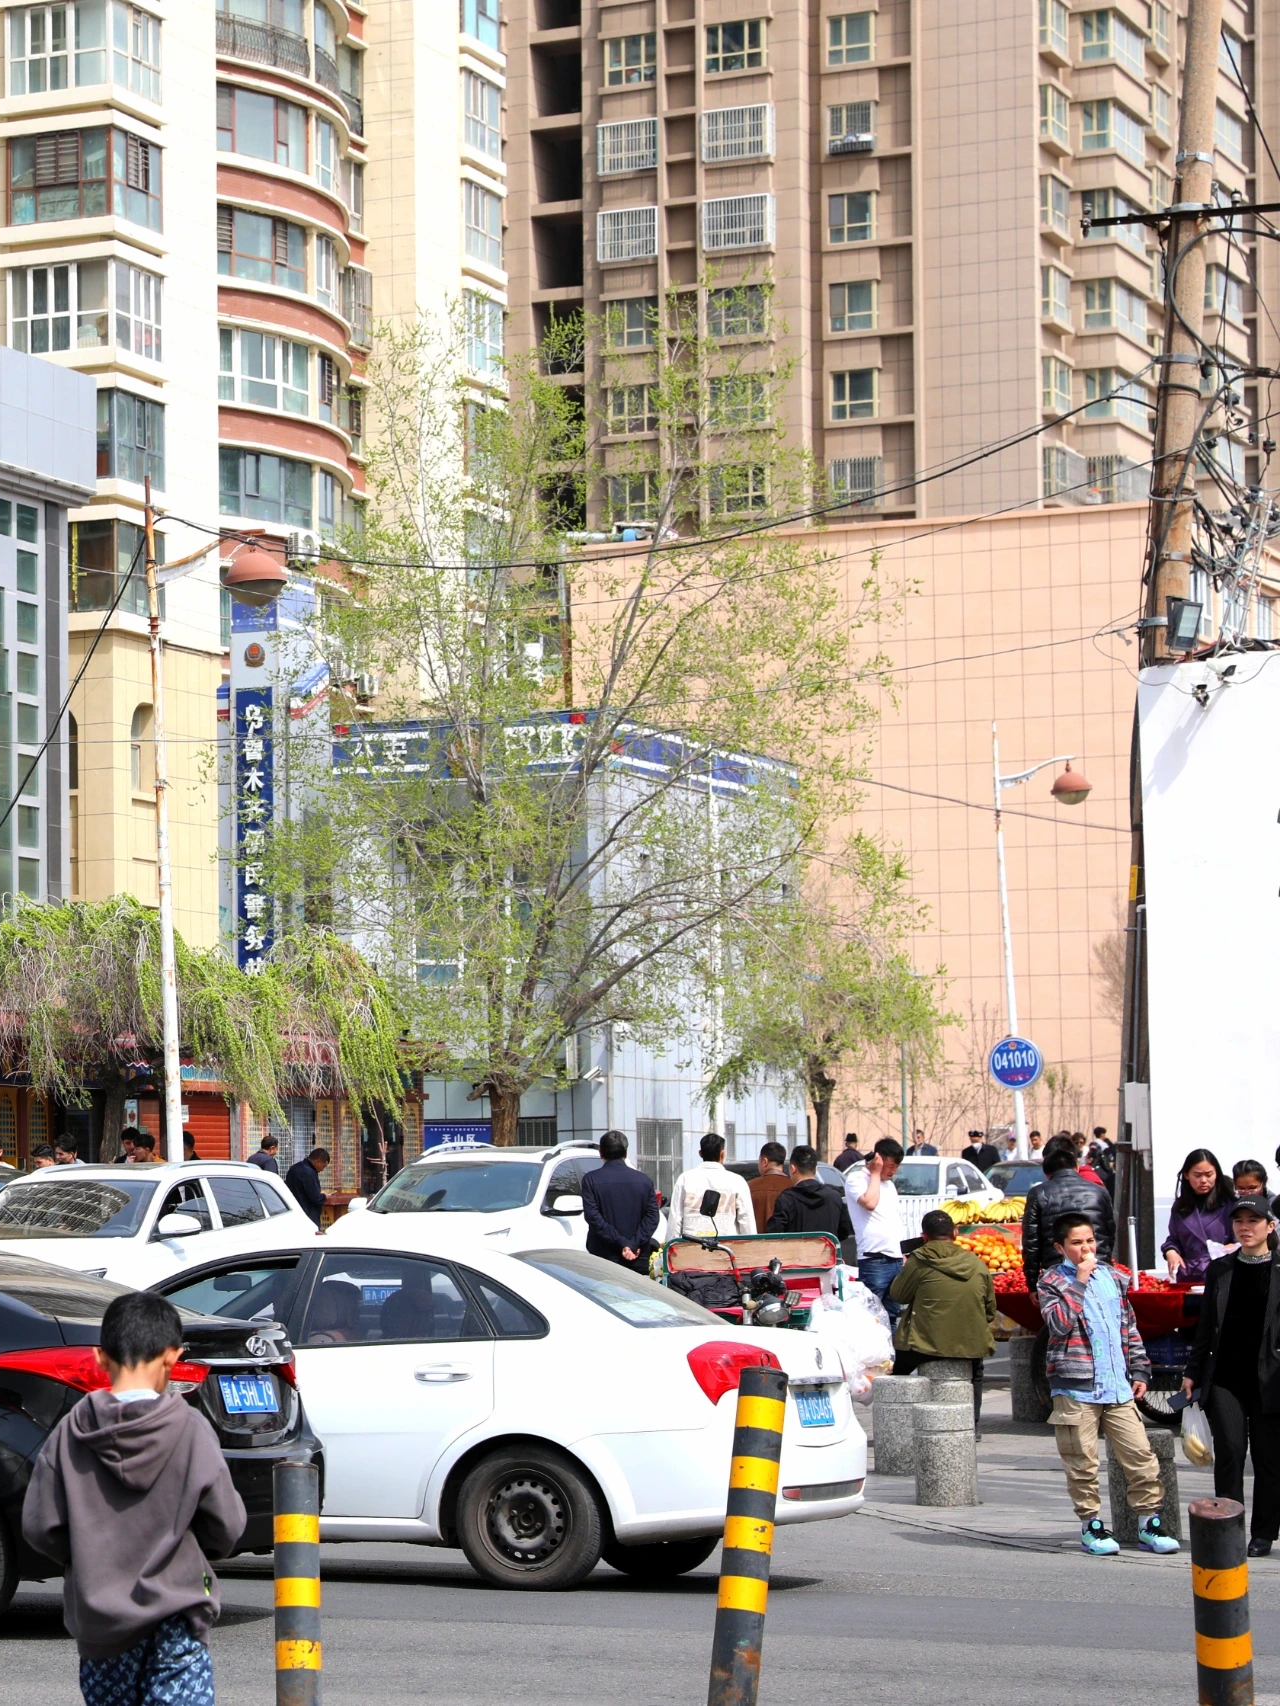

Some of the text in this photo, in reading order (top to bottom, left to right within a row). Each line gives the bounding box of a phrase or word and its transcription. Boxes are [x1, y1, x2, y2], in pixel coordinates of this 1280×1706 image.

[994, 1050, 1035, 1070] 041010
[442, 1133, 476, 1143] 天山区
